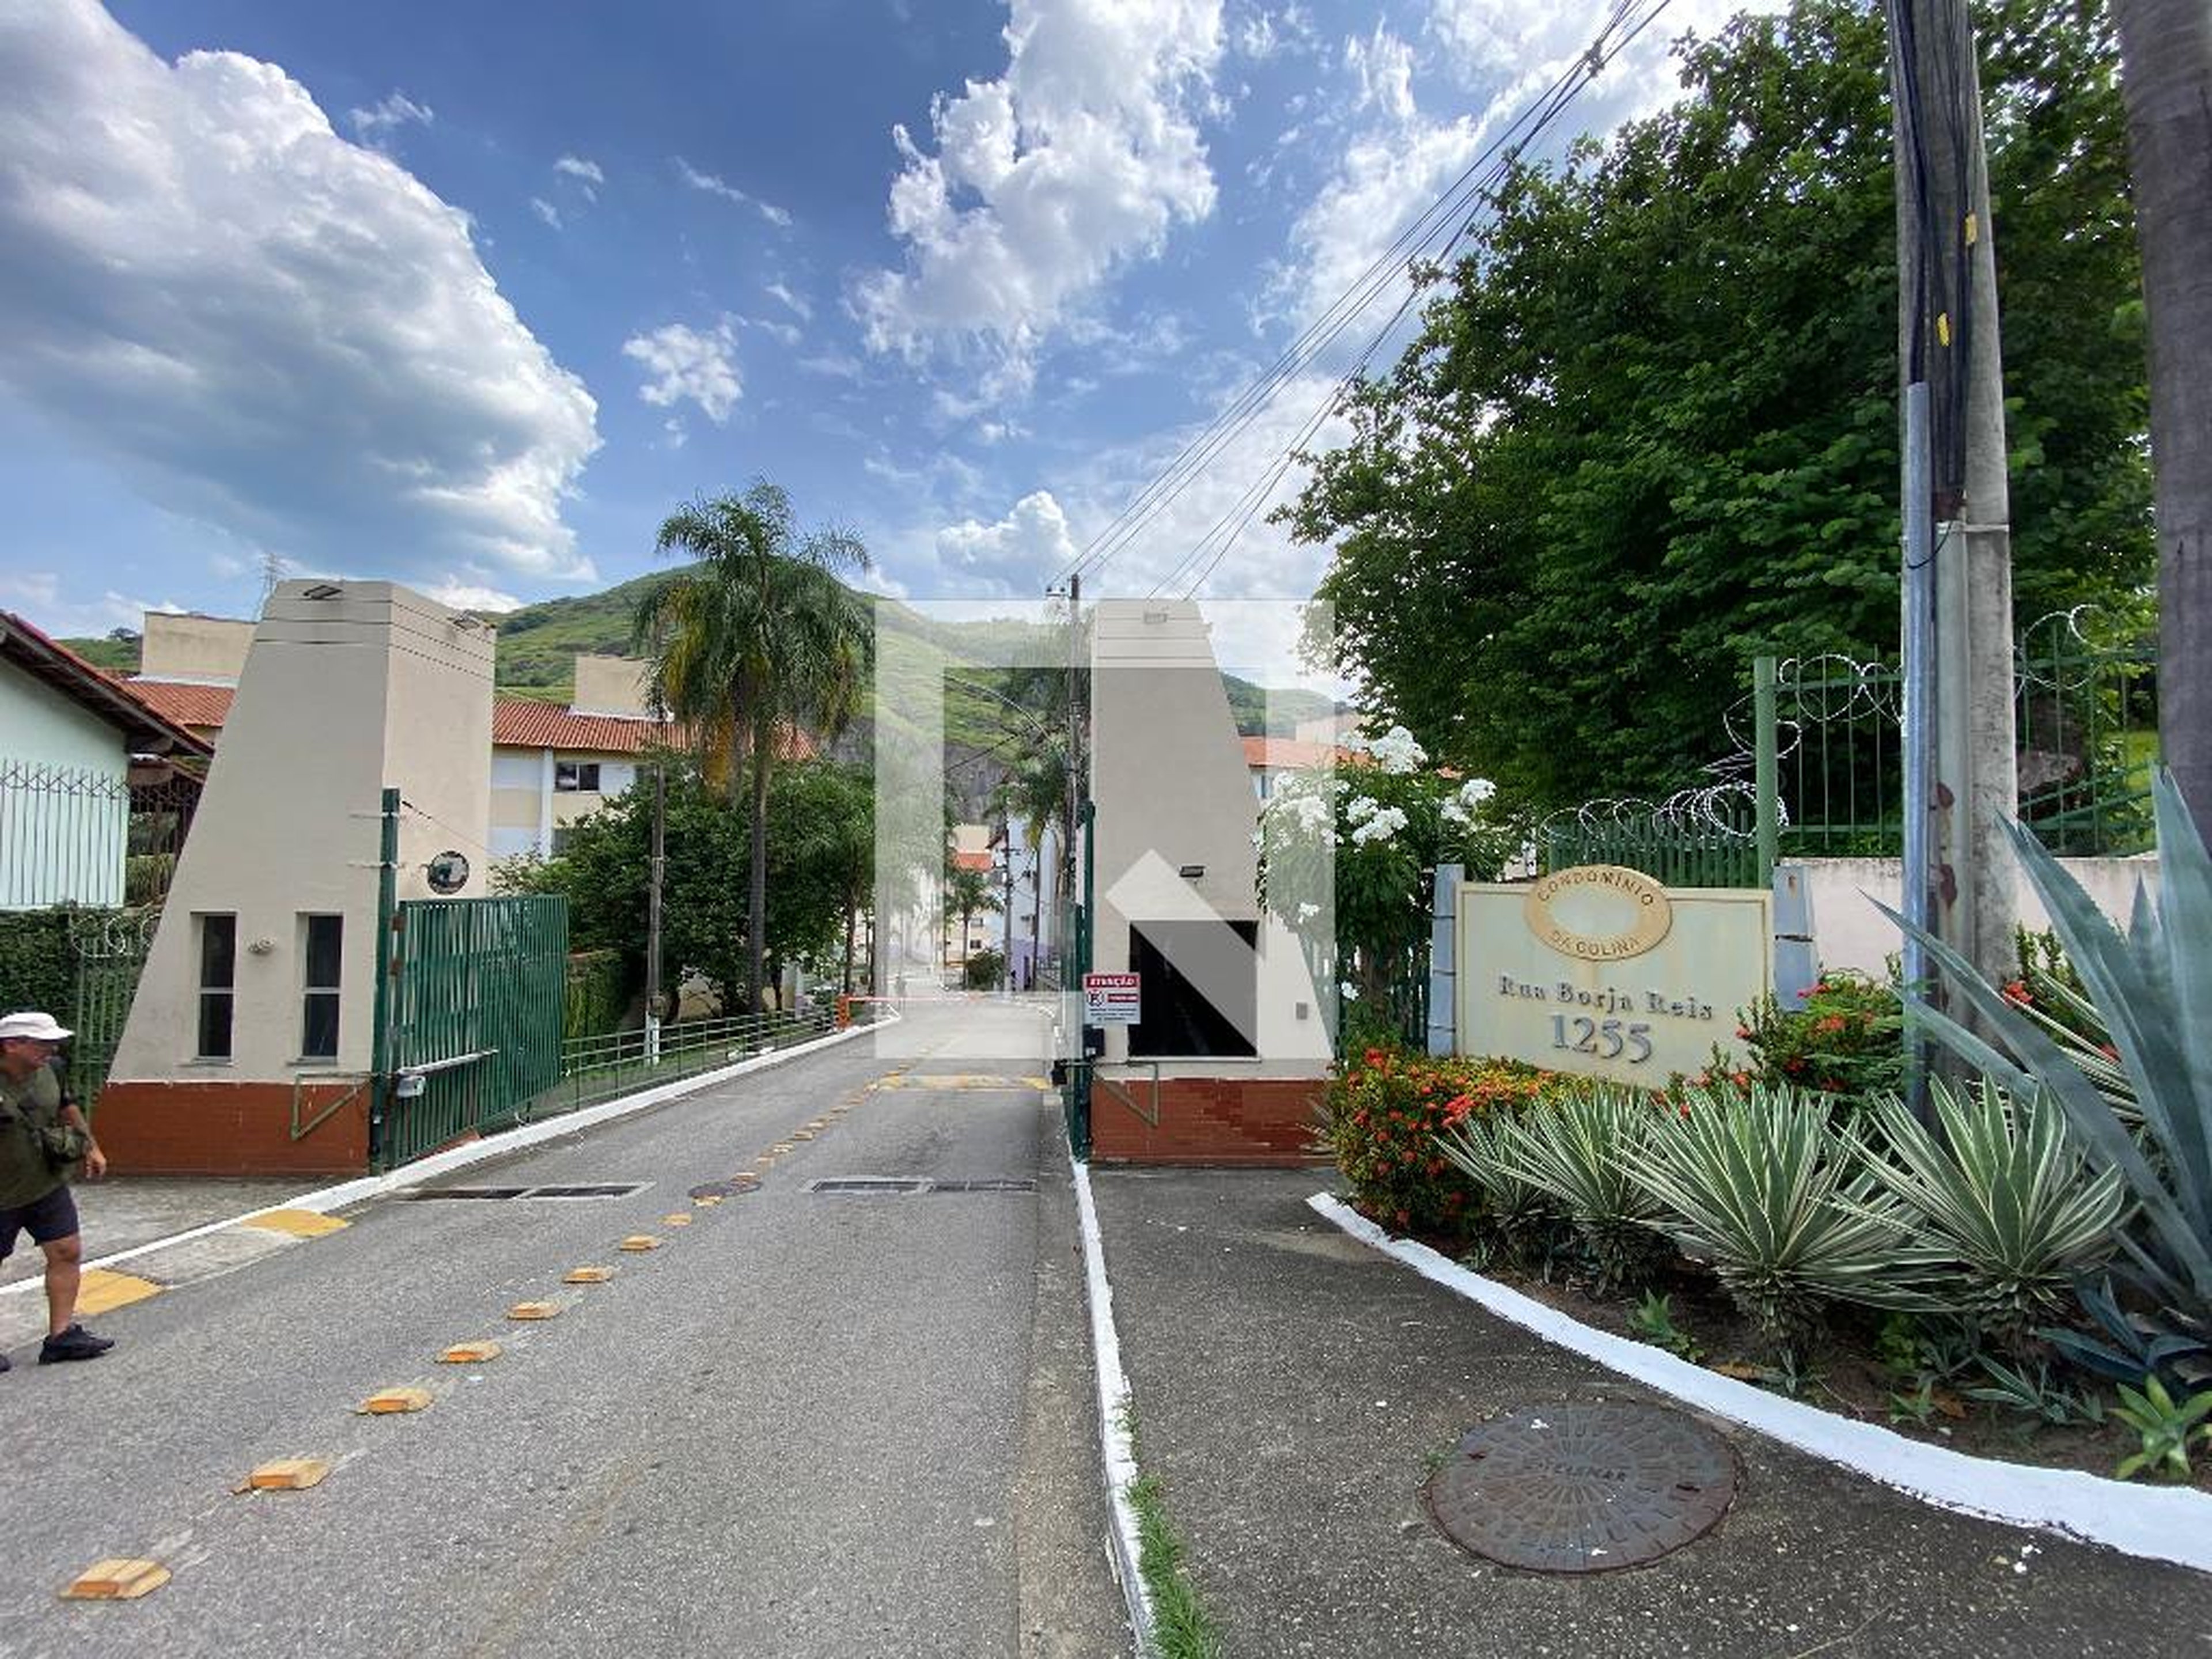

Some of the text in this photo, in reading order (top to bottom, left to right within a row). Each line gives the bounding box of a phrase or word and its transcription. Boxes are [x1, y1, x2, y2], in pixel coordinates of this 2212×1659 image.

[1576, 937, 1639, 956] COLINA
[1499, 975, 1712, 1020] Rua Borja Reis
[1552, 1014, 1652, 1064] 1255
